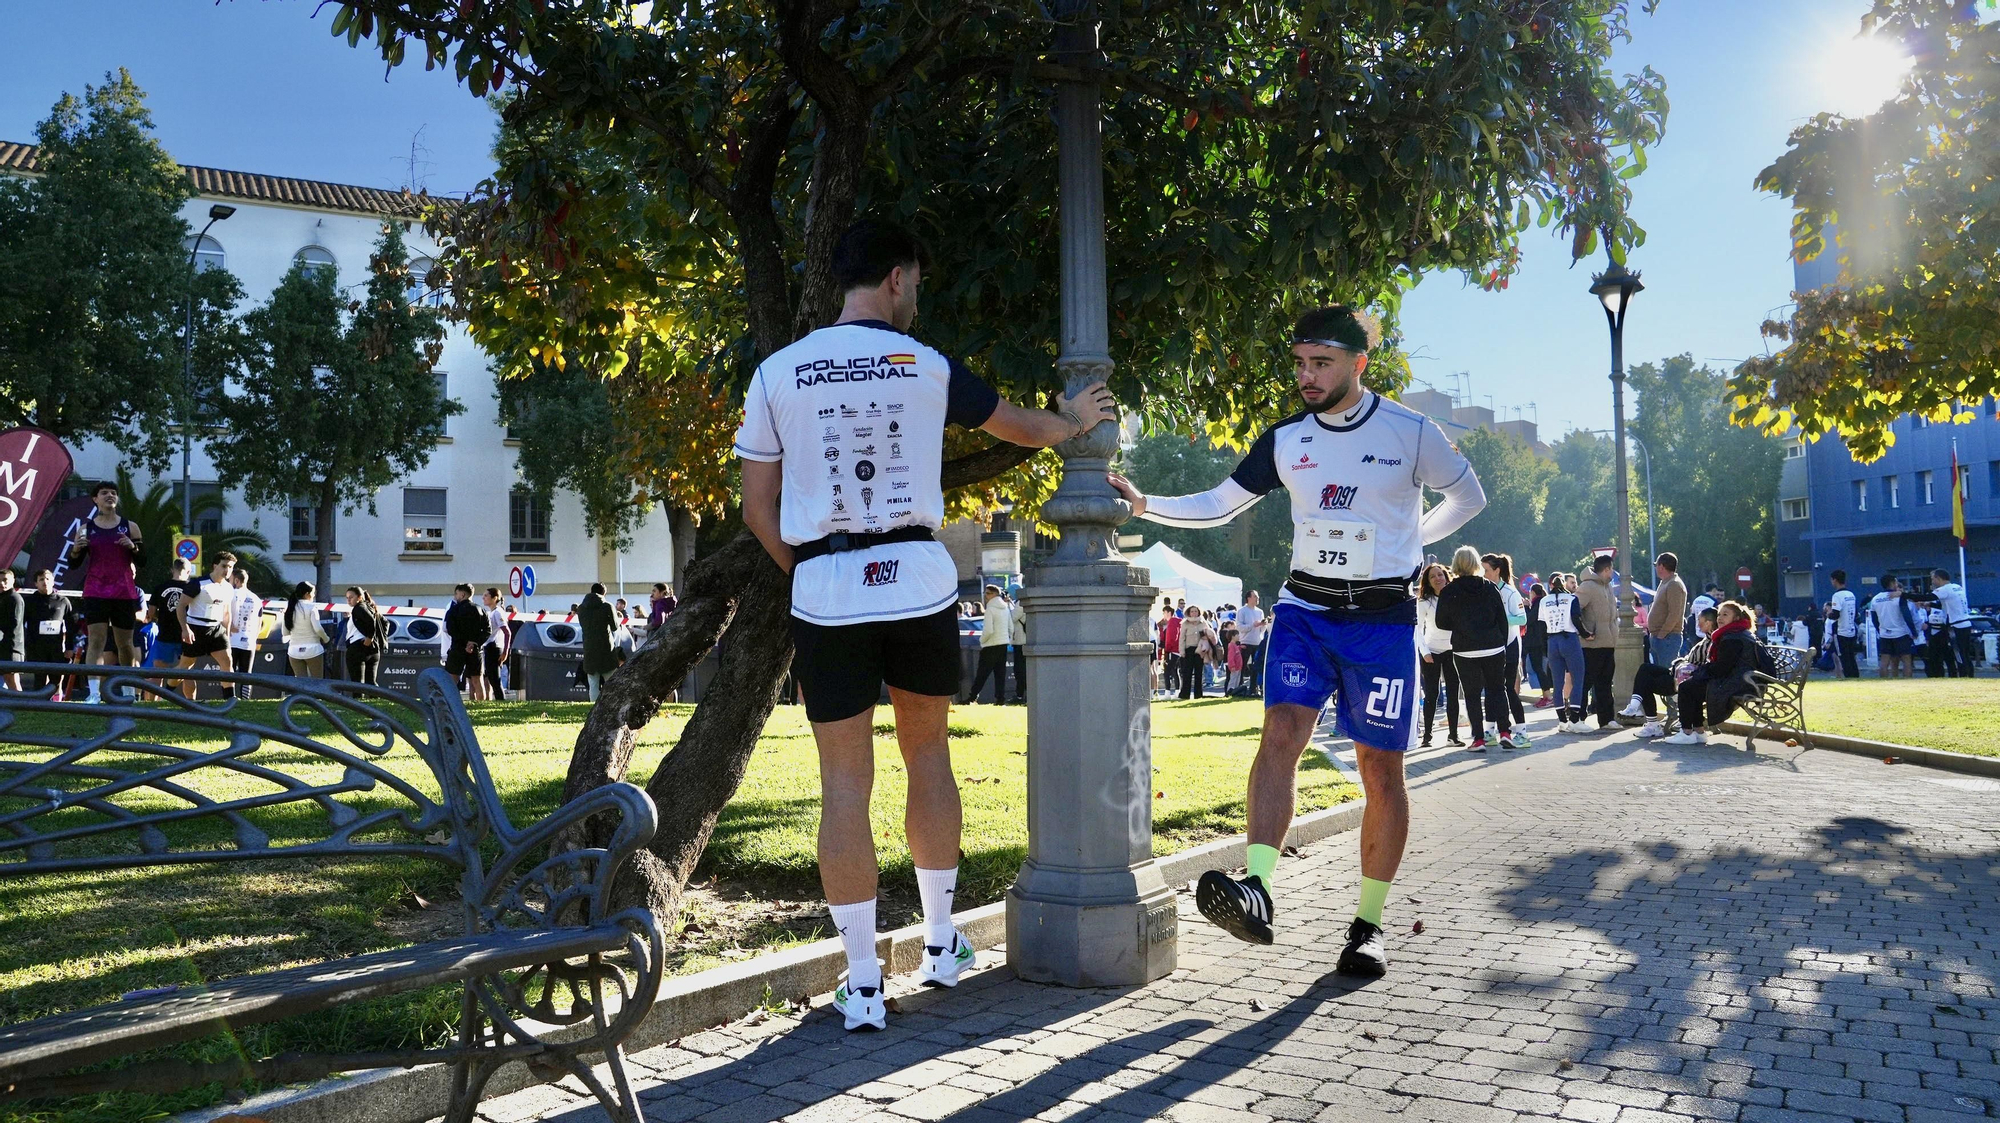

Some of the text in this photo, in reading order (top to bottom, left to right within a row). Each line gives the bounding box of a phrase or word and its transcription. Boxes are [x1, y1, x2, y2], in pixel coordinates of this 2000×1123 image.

[795, 355, 892, 377] POLICIA
[796, 366, 918, 389] NACIONAL
[1291, 462, 1319, 471] Santander
[1378, 458, 1402, 467] mupol
[889, 510, 912, 519] COVAP
[1317, 549, 1348, 567] 375
[391, 666, 416, 675] sadeco
[1365, 676, 1405, 720] 20
[1366, 718, 1395, 730] Kromex
